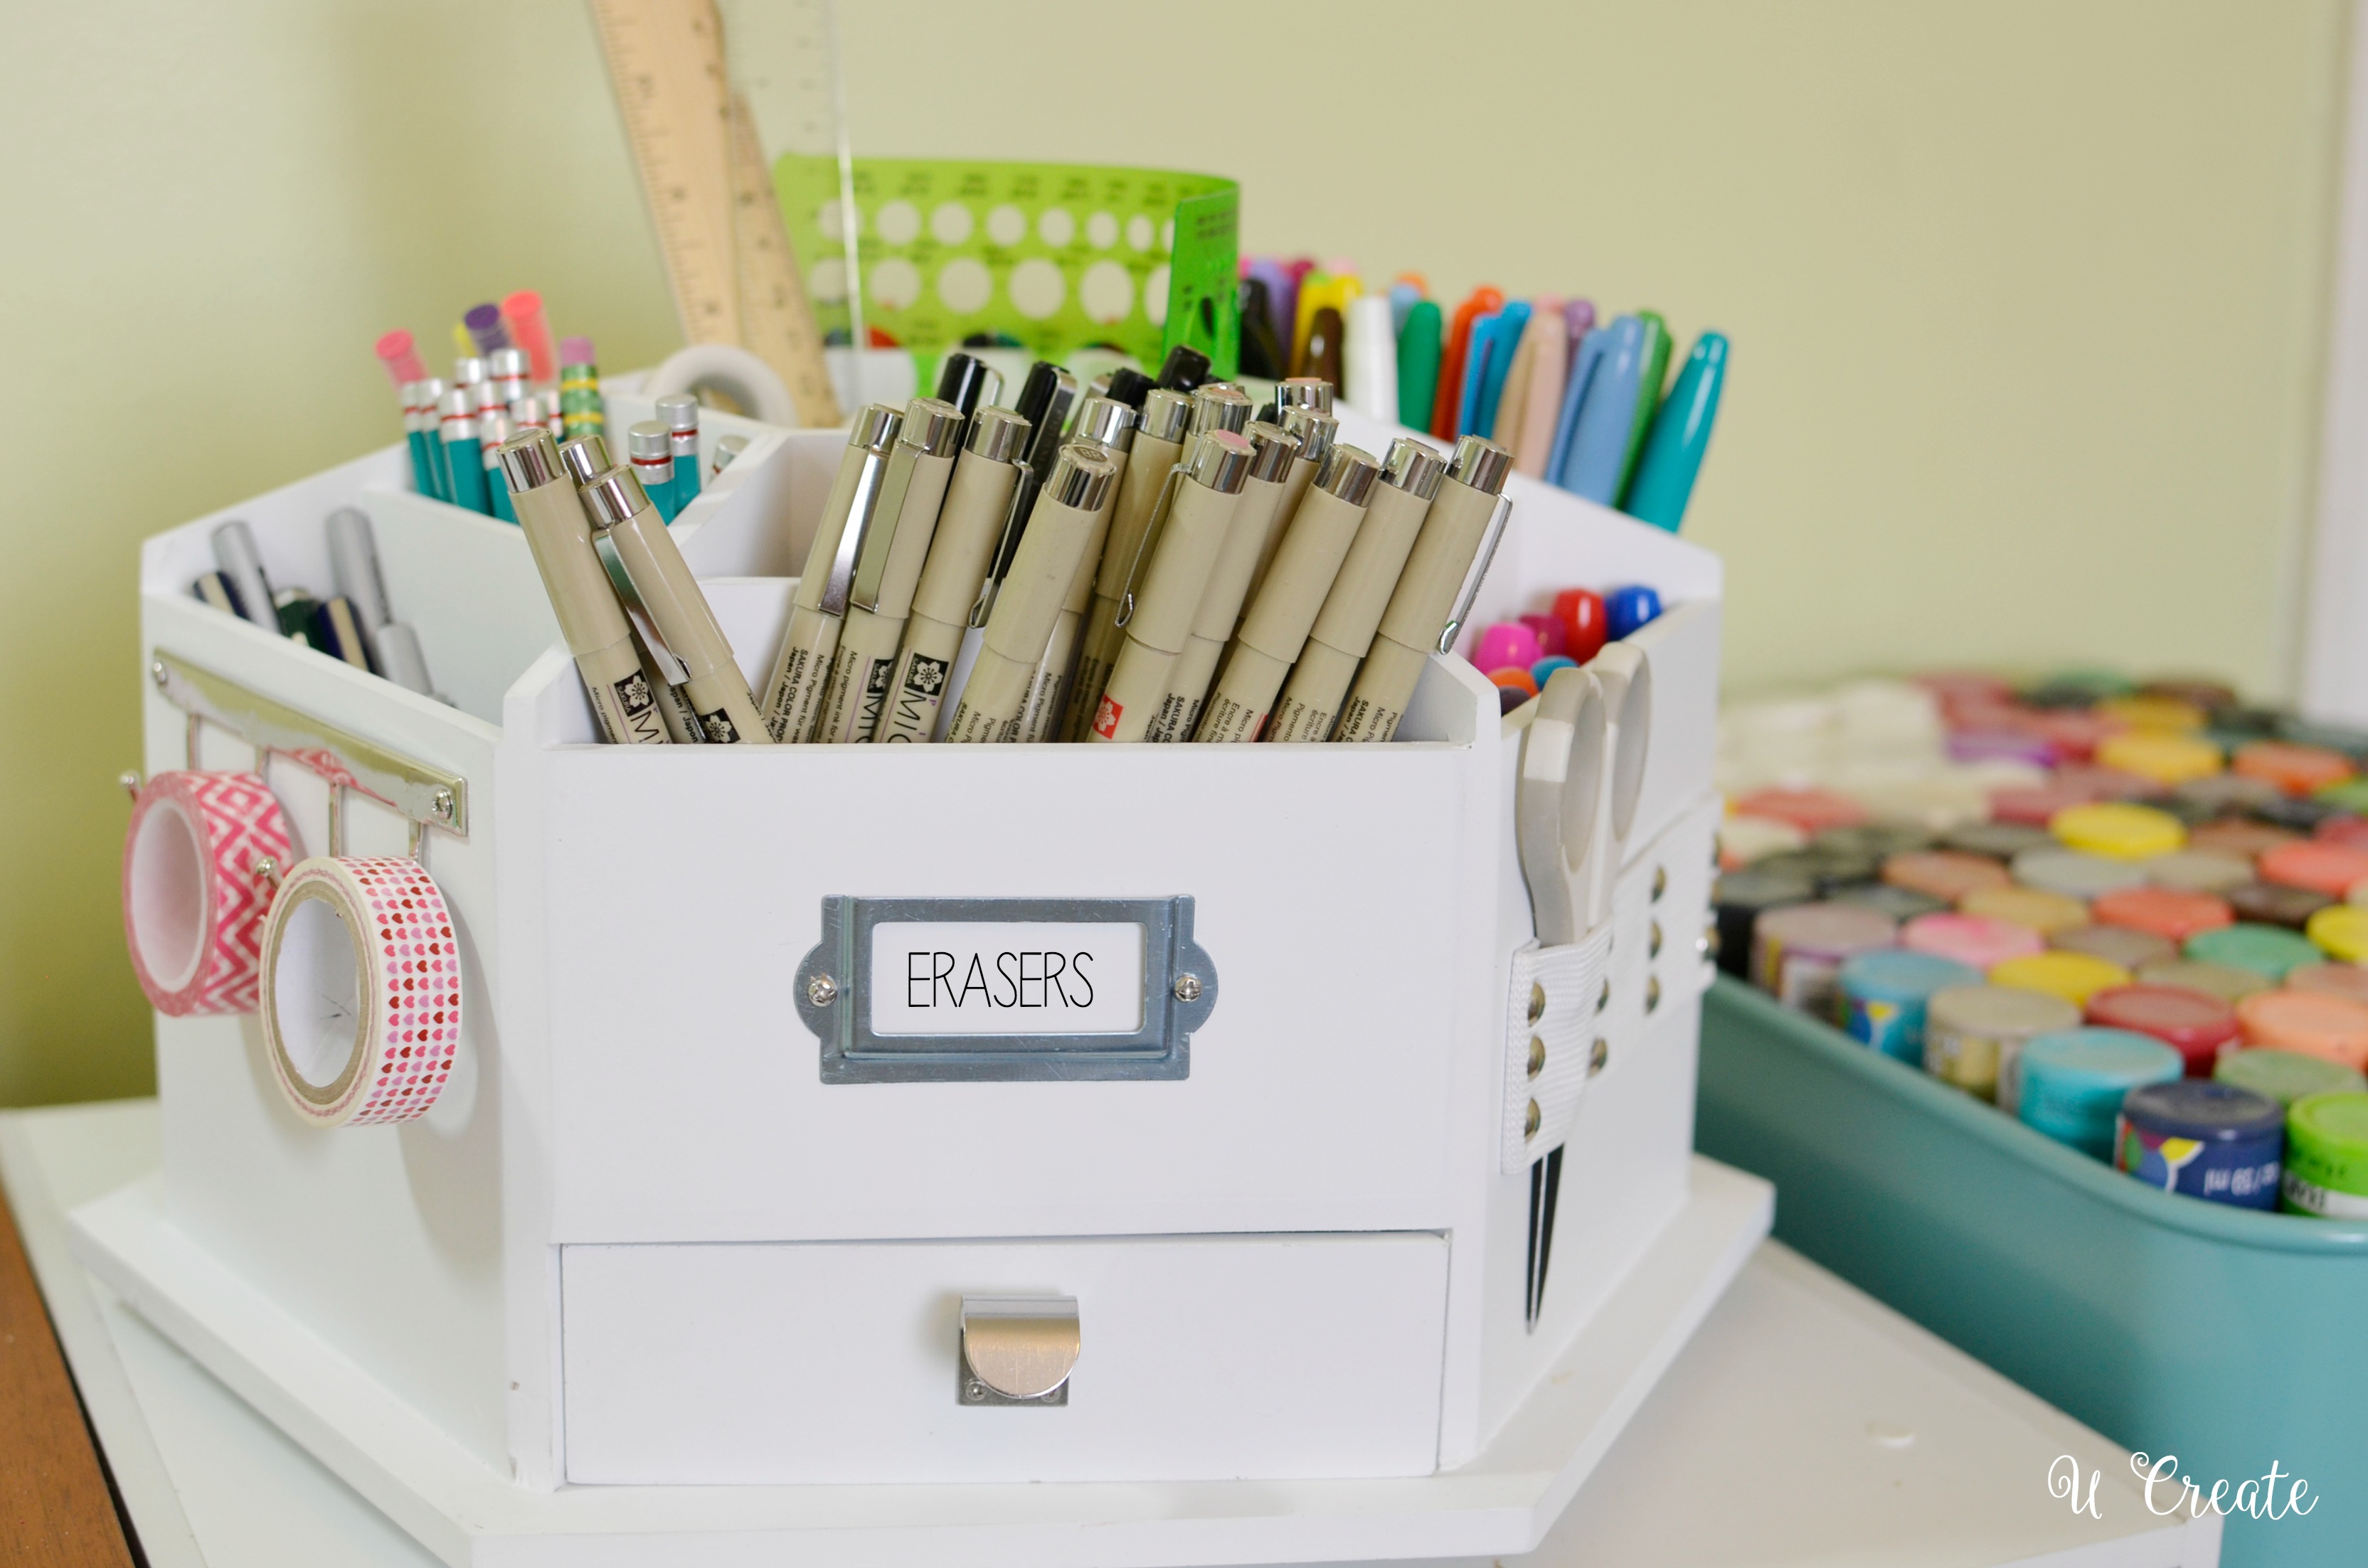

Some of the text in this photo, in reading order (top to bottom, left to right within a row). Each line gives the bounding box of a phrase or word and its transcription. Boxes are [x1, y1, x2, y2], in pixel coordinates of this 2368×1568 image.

[1080, 449, 1103, 461] BR
[786, 646, 799, 673] Japan
[792, 649, 808, 684] SAKURA
[812, 654, 825, 678] Micro
[845, 651, 858, 675] Micro
[906, 657, 919, 683] SAKURA
[867, 663, 881, 690] SAKURA
[1039, 672, 1052, 696] Micro
[592, 687, 604, 710] Micro
[617, 686, 632, 713] SAKURA
[775, 681, 789, 708] Japon
[782, 687, 797, 716] COLOR
[801, 679, 817, 713] Pigment
[836, 676, 850, 710] pigment
[1160, 693, 1175, 720] Japan
[797, 715, 806, 727] für
[832, 711, 842, 723] ink
[951, 702, 967, 736] SAKURA
[1029, 698, 1045, 732] Pigment
[1167, 696, 1185, 731] SAKURA
[1186, 699, 1199, 722] Micro
[1201, 692, 1221, 730] Pigmento
[1213, 698, 1231, 729] écriture
[1224, 703, 1240, 725] Encre
[1238, 709, 1254, 732] Micro
[1280, 696, 1292, 720] Micro
[1346, 696, 1361, 722] Japan
[1349, 700, 1369, 735] SAKURA
[1369, 707, 1386, 730] Micro
[683, 715, 699, 742] Japon
[829, 725, 839, 737] for
[967, 711, 981, 734] Micro
[1284, 703, 1305, 742] Pigmento
[1302, 710, 1319, 740] écriture
[1312, 712, 1327, 735] Encre
[908, 951, 1094, 1008] ERASERS
